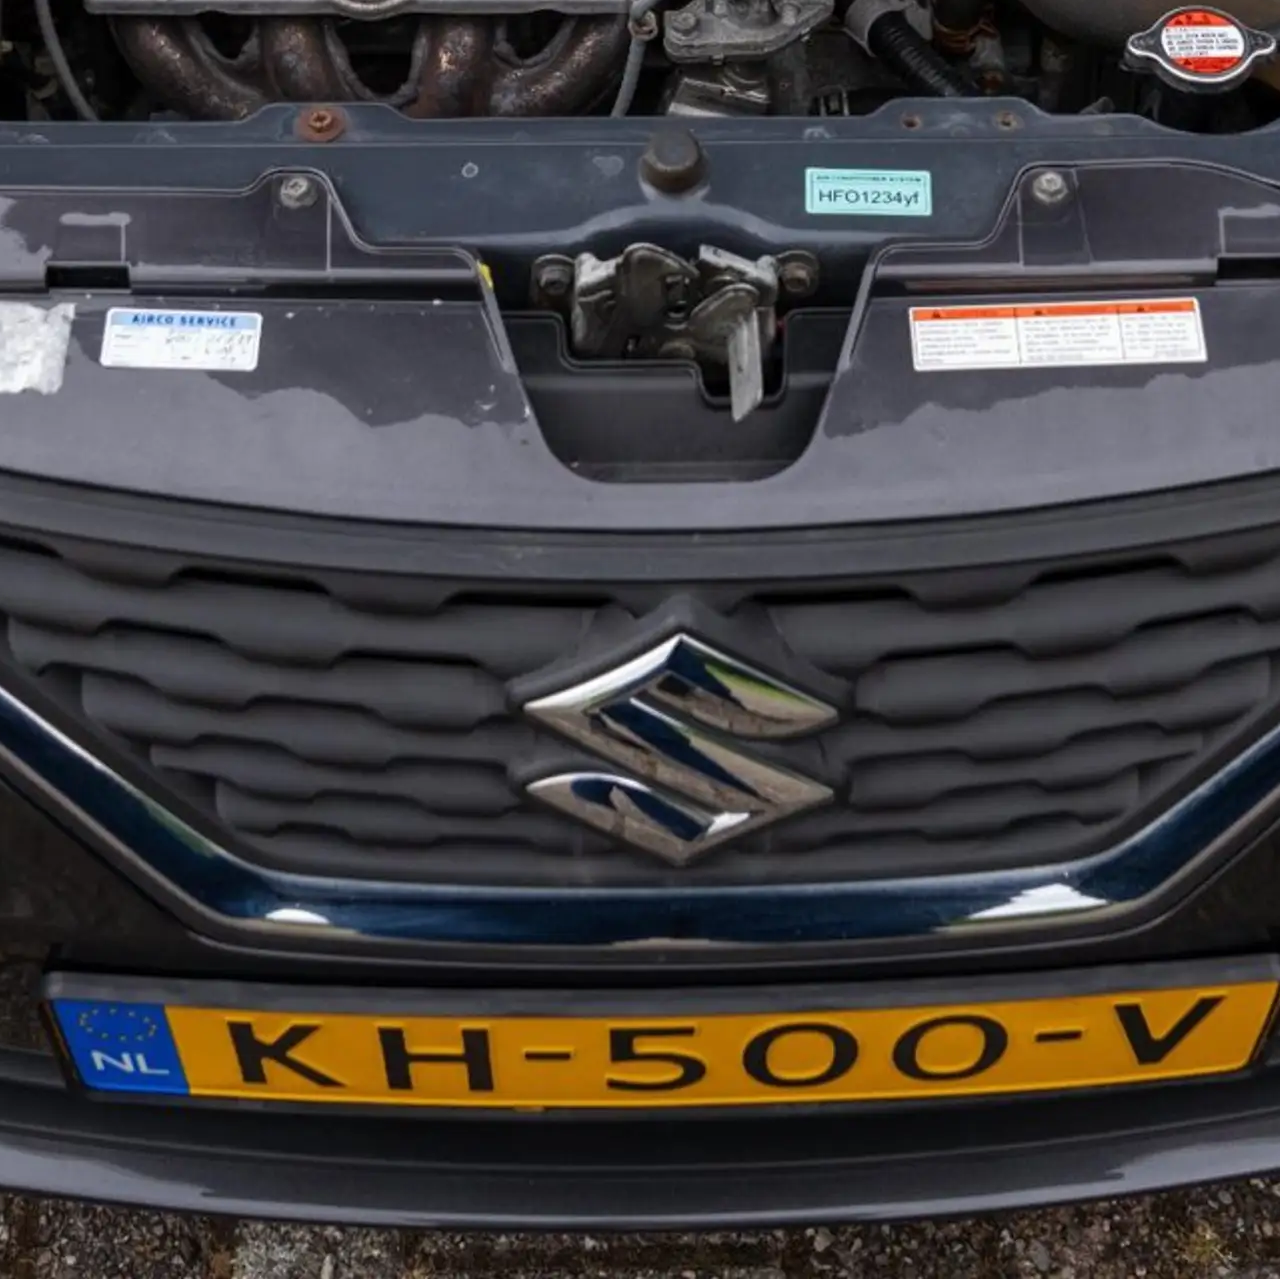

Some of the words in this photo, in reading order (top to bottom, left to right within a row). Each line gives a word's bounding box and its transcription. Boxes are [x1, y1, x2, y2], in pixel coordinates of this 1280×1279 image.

[819, 189, 919, 207] HFO1234yf
[132, 314, 174, 325] AIRCO
[180, 316, 237, 327] SERVICE
[227, 997, 1224, 1090] KH-500-V
[91, 1050, 170, 1075] NL
